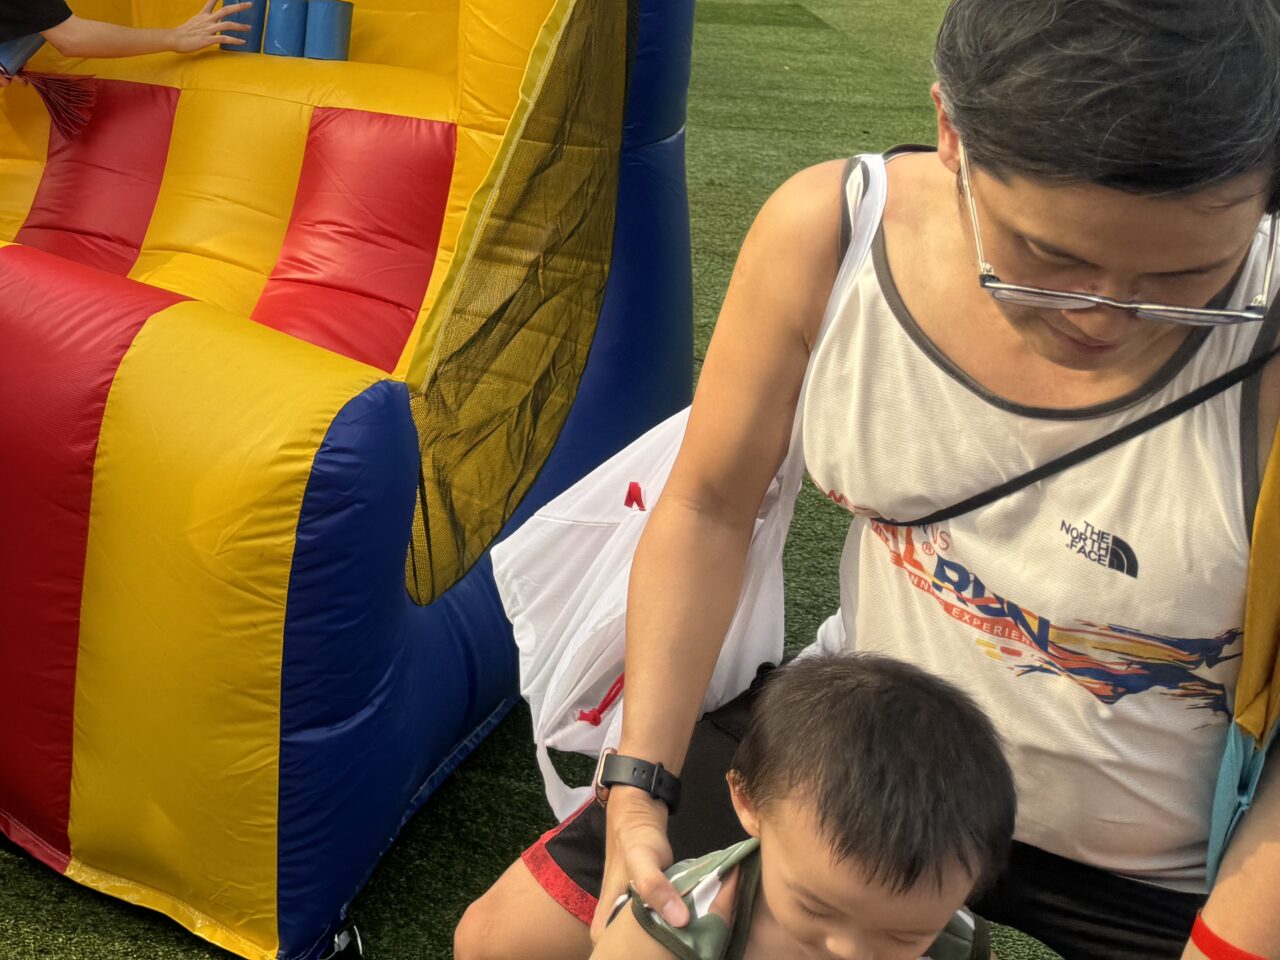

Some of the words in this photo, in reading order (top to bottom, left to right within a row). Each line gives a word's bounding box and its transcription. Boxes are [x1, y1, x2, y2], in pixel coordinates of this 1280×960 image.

[1060, 519, 1110, 558] NORTH
[1084, 520, 1111, 545] THE
[1070, 539, 1107, 567] FACE
[932, 554, 1051, 653] RUN
[951, 607, 1032, 646] EXPERIEN
